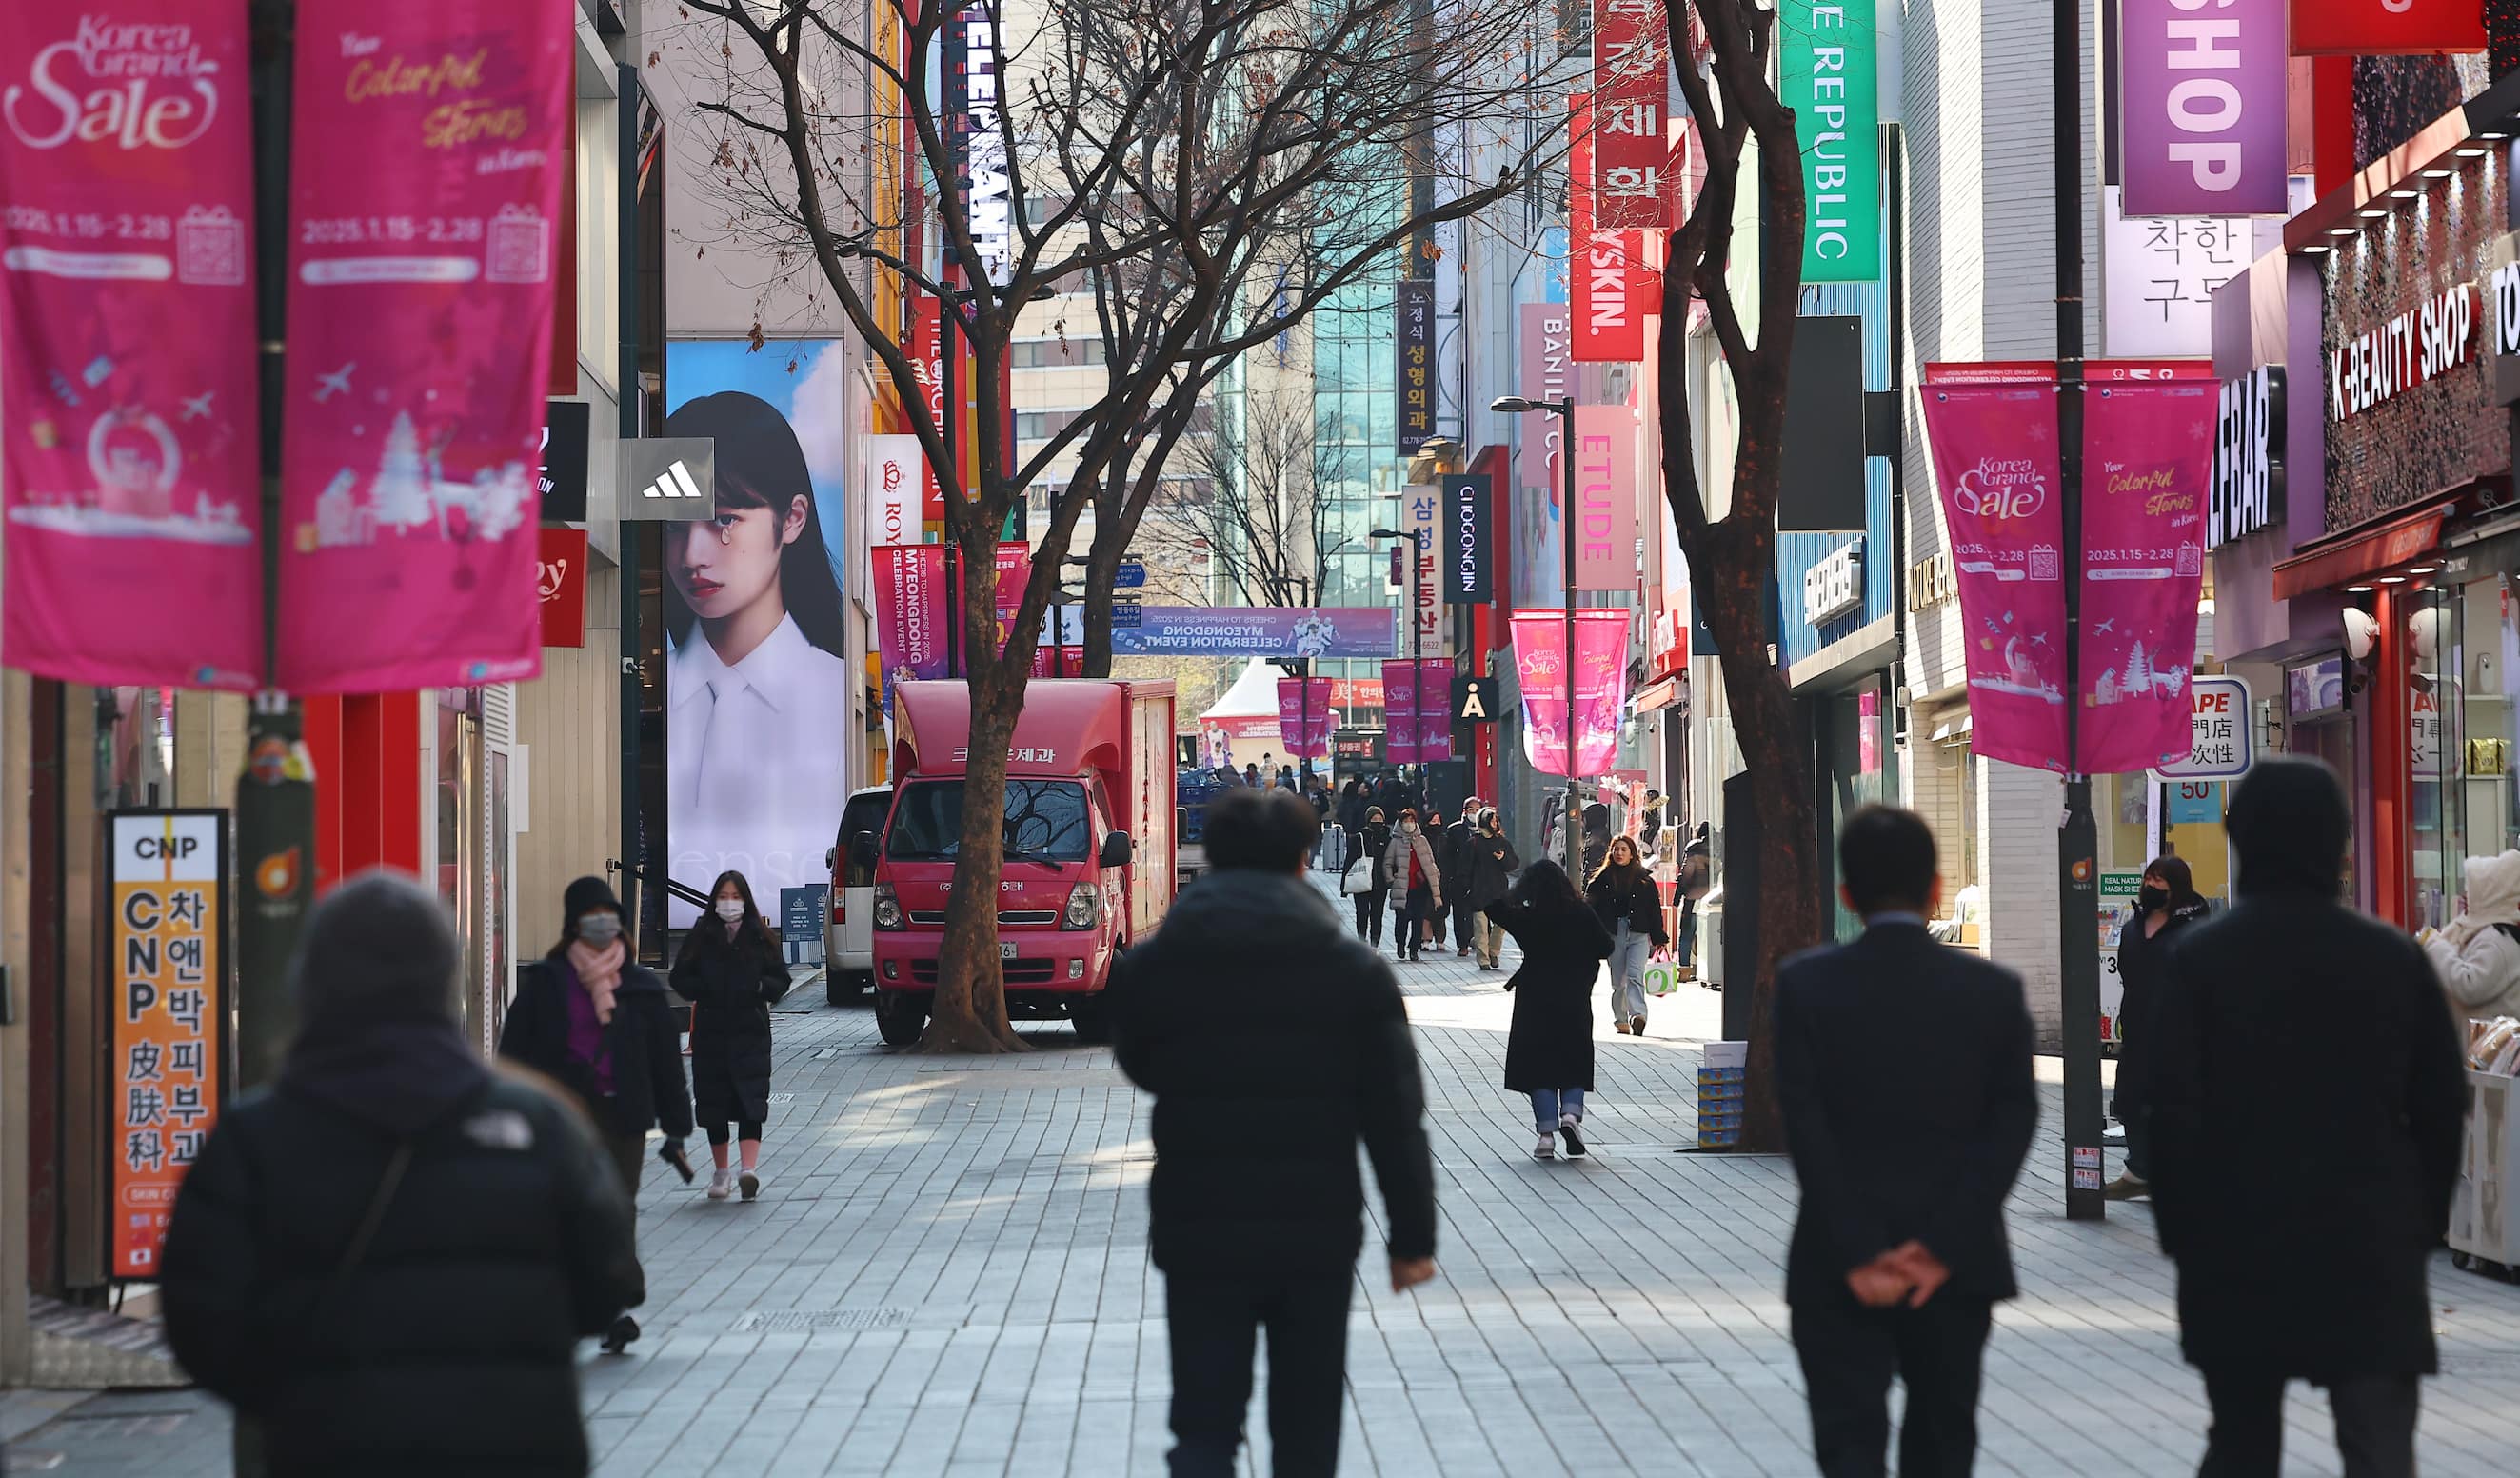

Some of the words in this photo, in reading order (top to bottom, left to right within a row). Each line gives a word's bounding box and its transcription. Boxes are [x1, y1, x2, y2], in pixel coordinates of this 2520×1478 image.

[78, 15, 192, 50] Korea
[1813, 6, 1844, 30] E
[4, 40, 219, 150] Sale
[2167, 0, 2242, 192] HOP
[1813, 47, 1848, 260] REPUBLIC
[1409, 291, 1426, 341] 노정식
[2331, 310, 2415, 423] K-BEAUTY
[2420, 283, 2470, 382] SHOP
[1406, 344, 1428, 430] 성형외과
[1979, 456, 2032, 473] Korea
[1983, 468, 2036, 487] Grand
[2104, 461, 2125, 473] Your
[2107, 468, 2175, 494] Colorful
[1583, 435, 1612, 561] ETUDE
[1954, 469, 2046, 520] Sale
[2144, 492, 2193, 516] Stories
[2087, 548, 2174, 562] 2025.1.15-2.28
[892, 549, 904, 617] CELEBRATION
[904, 549, 923, 664] MYEONGDONG
[897, 617, 906, 653] EVENT
[1520, 653, 1559, 674] Sale
[2191, 743, 2234, 765] 次性
[134, 837, 198, 861] CNP
[2104, 885, 2124, 893] MASK
[124, 891, 160, 1023] CNP
[168, 891, 208, 1167] 차앤박피부과
